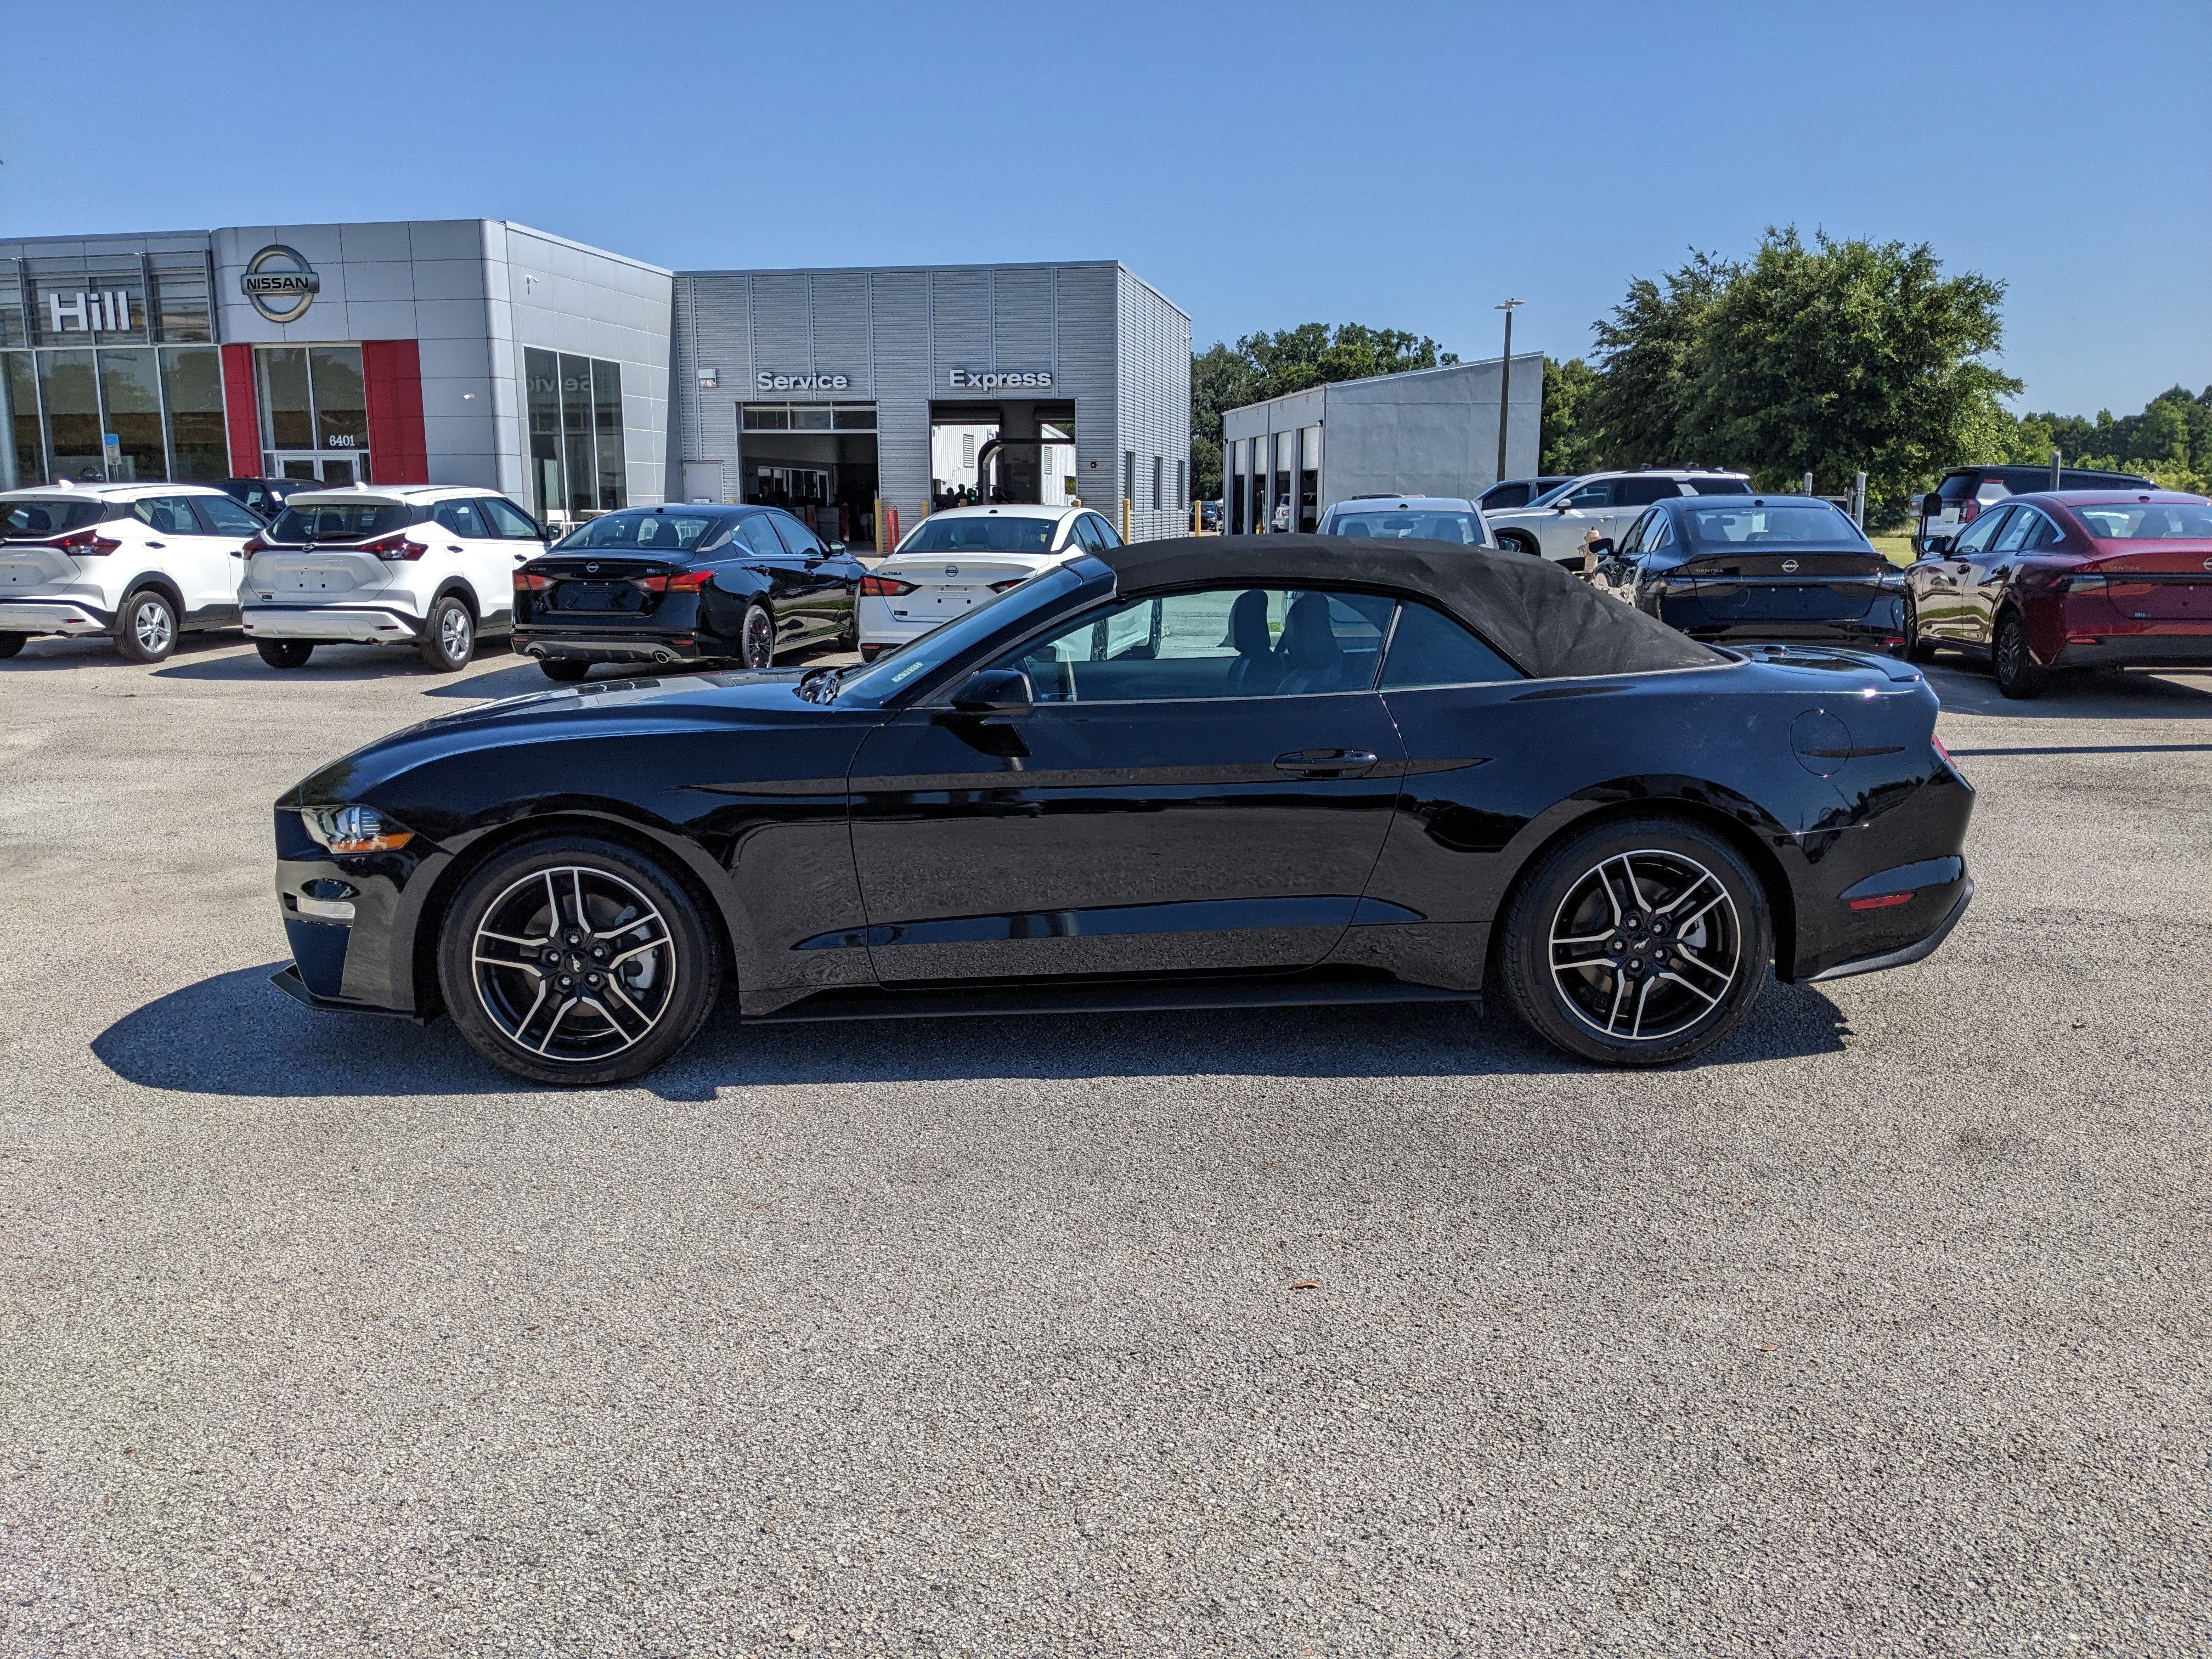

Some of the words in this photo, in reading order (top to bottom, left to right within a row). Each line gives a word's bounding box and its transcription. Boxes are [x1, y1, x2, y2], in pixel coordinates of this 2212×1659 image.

[247, 277, 308, 290] NISSAN
[50, 291, 130, 332] Hill
[757, 372, 848, 390] Service
[950, 369, 1052, 392] Express
[329, 435, 356, 447] 6401
